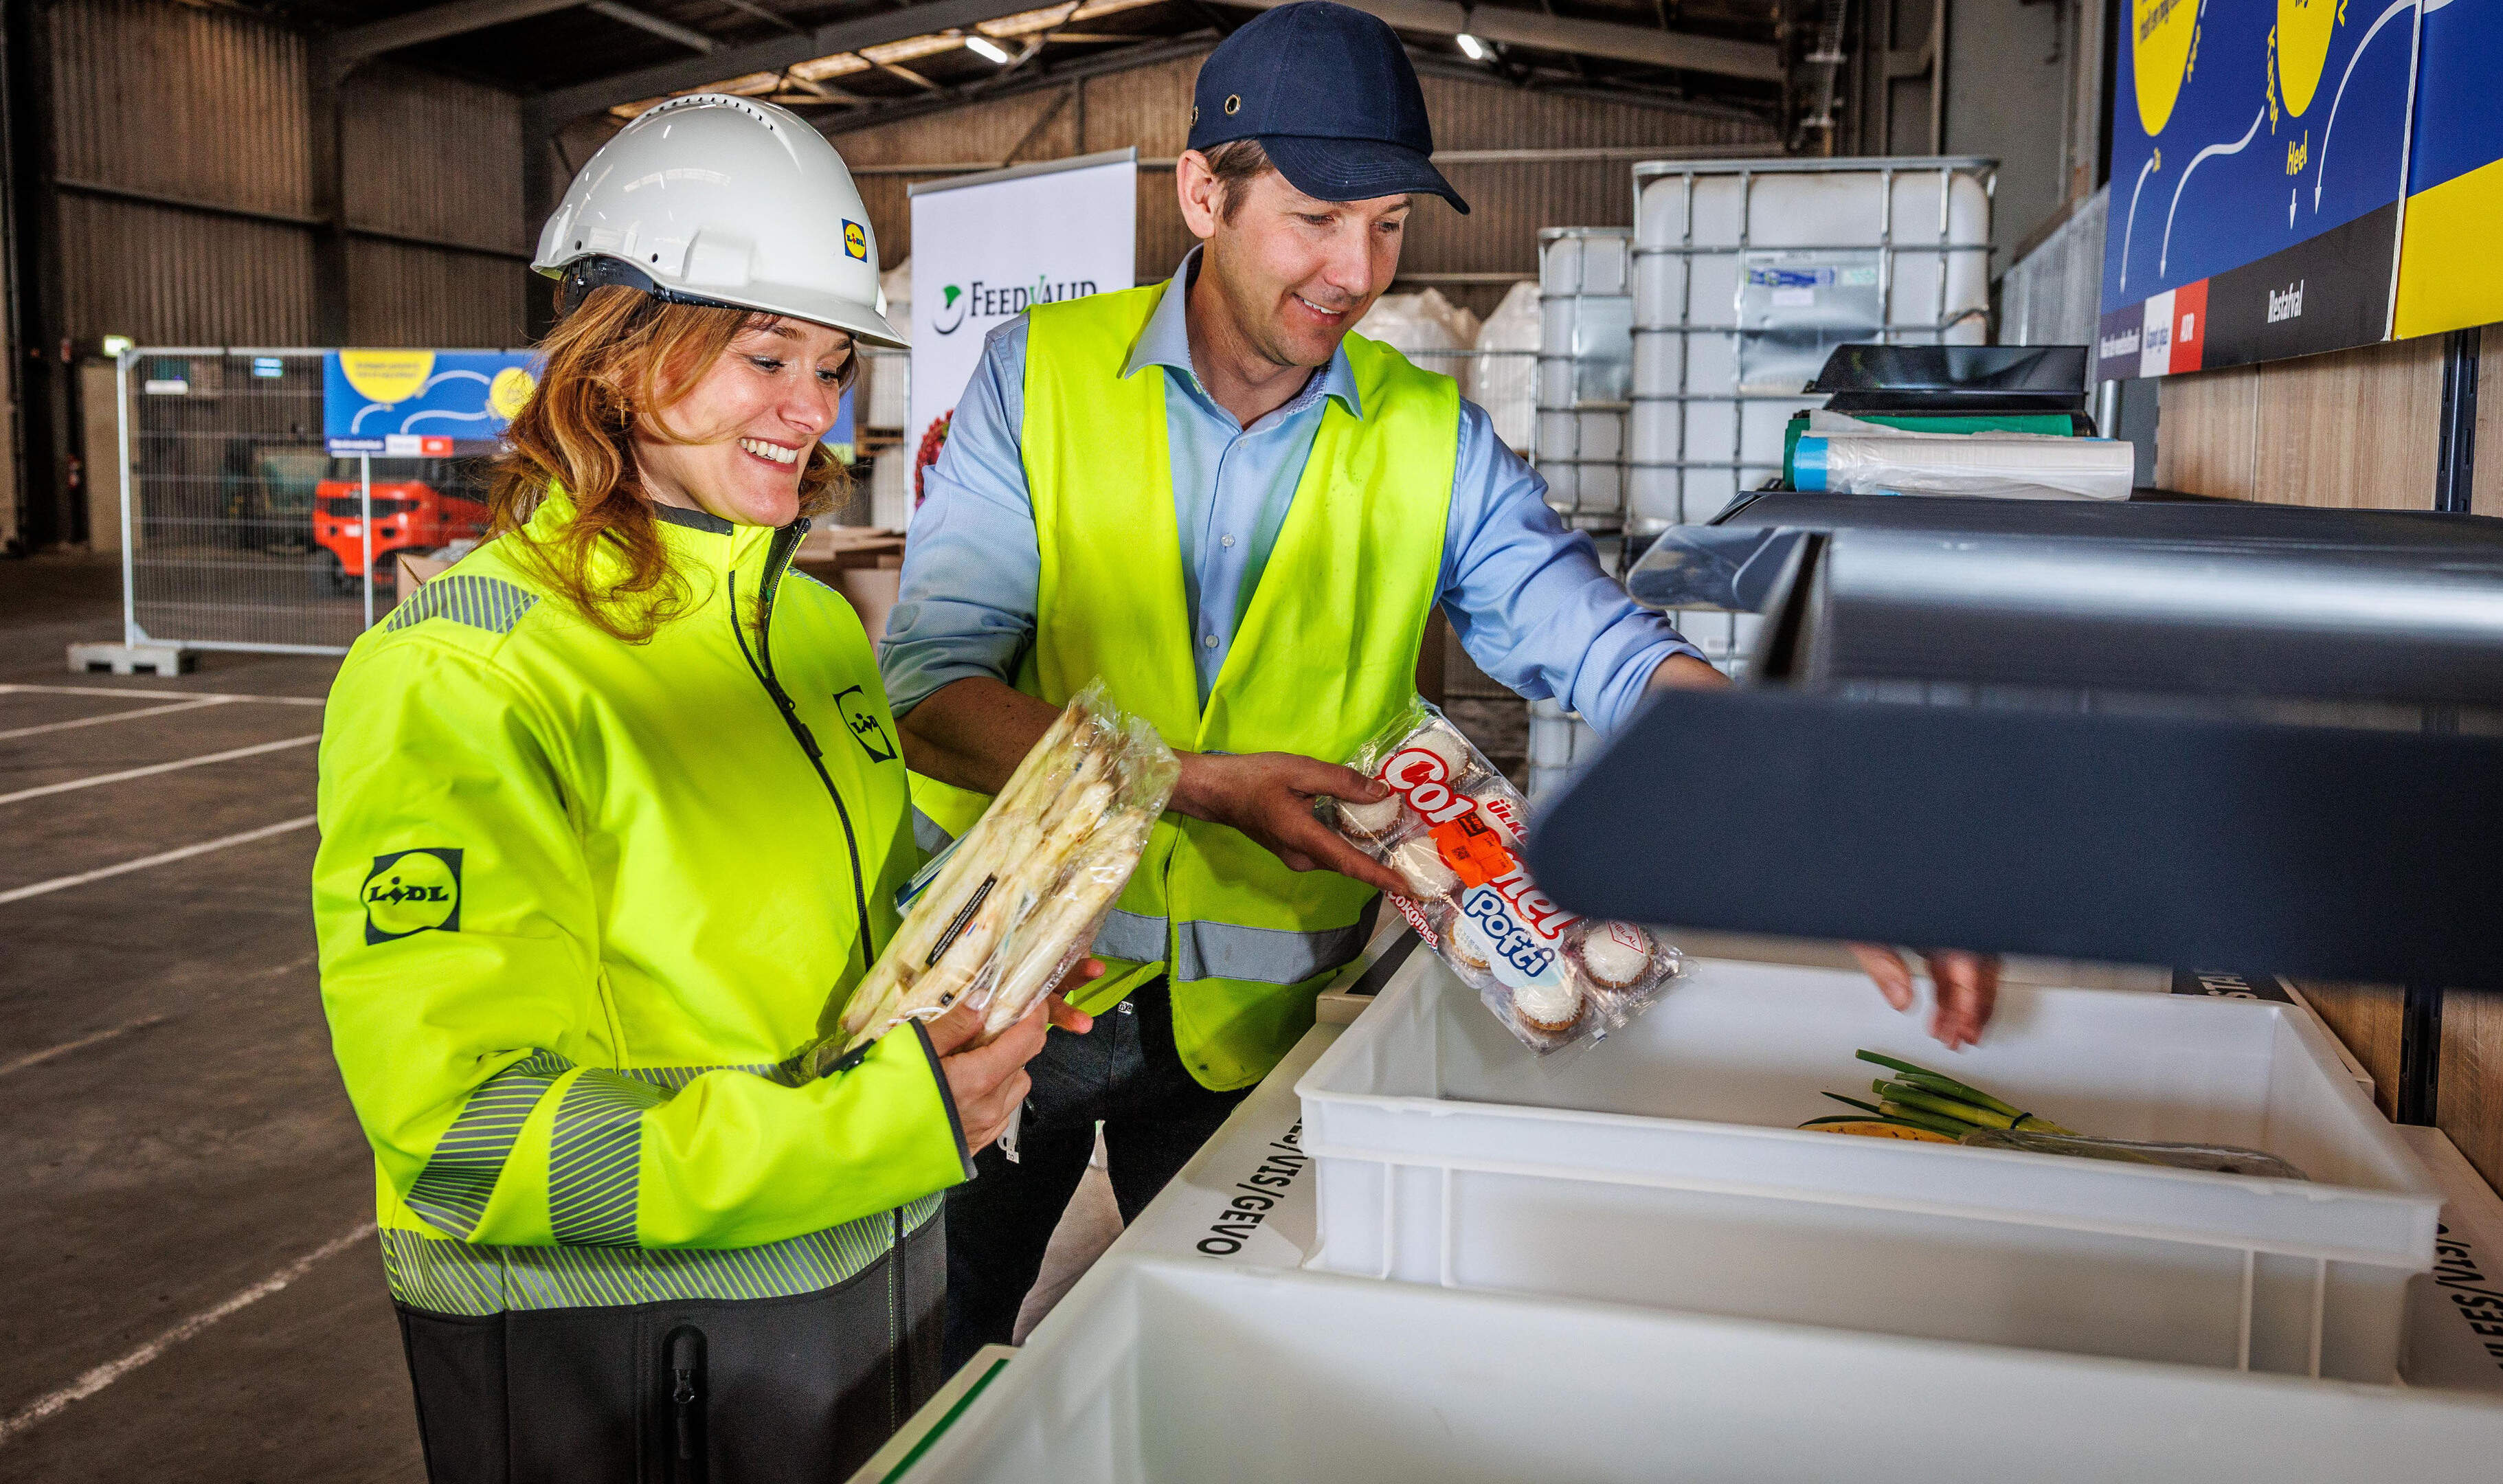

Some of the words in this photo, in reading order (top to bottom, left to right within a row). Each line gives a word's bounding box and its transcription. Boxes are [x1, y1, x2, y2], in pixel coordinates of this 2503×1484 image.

[2286, 129, 2308, 176] Heel
[2267, 279, 2304, 323] Restafval
[1464, 890, 1556, 978] pofti
